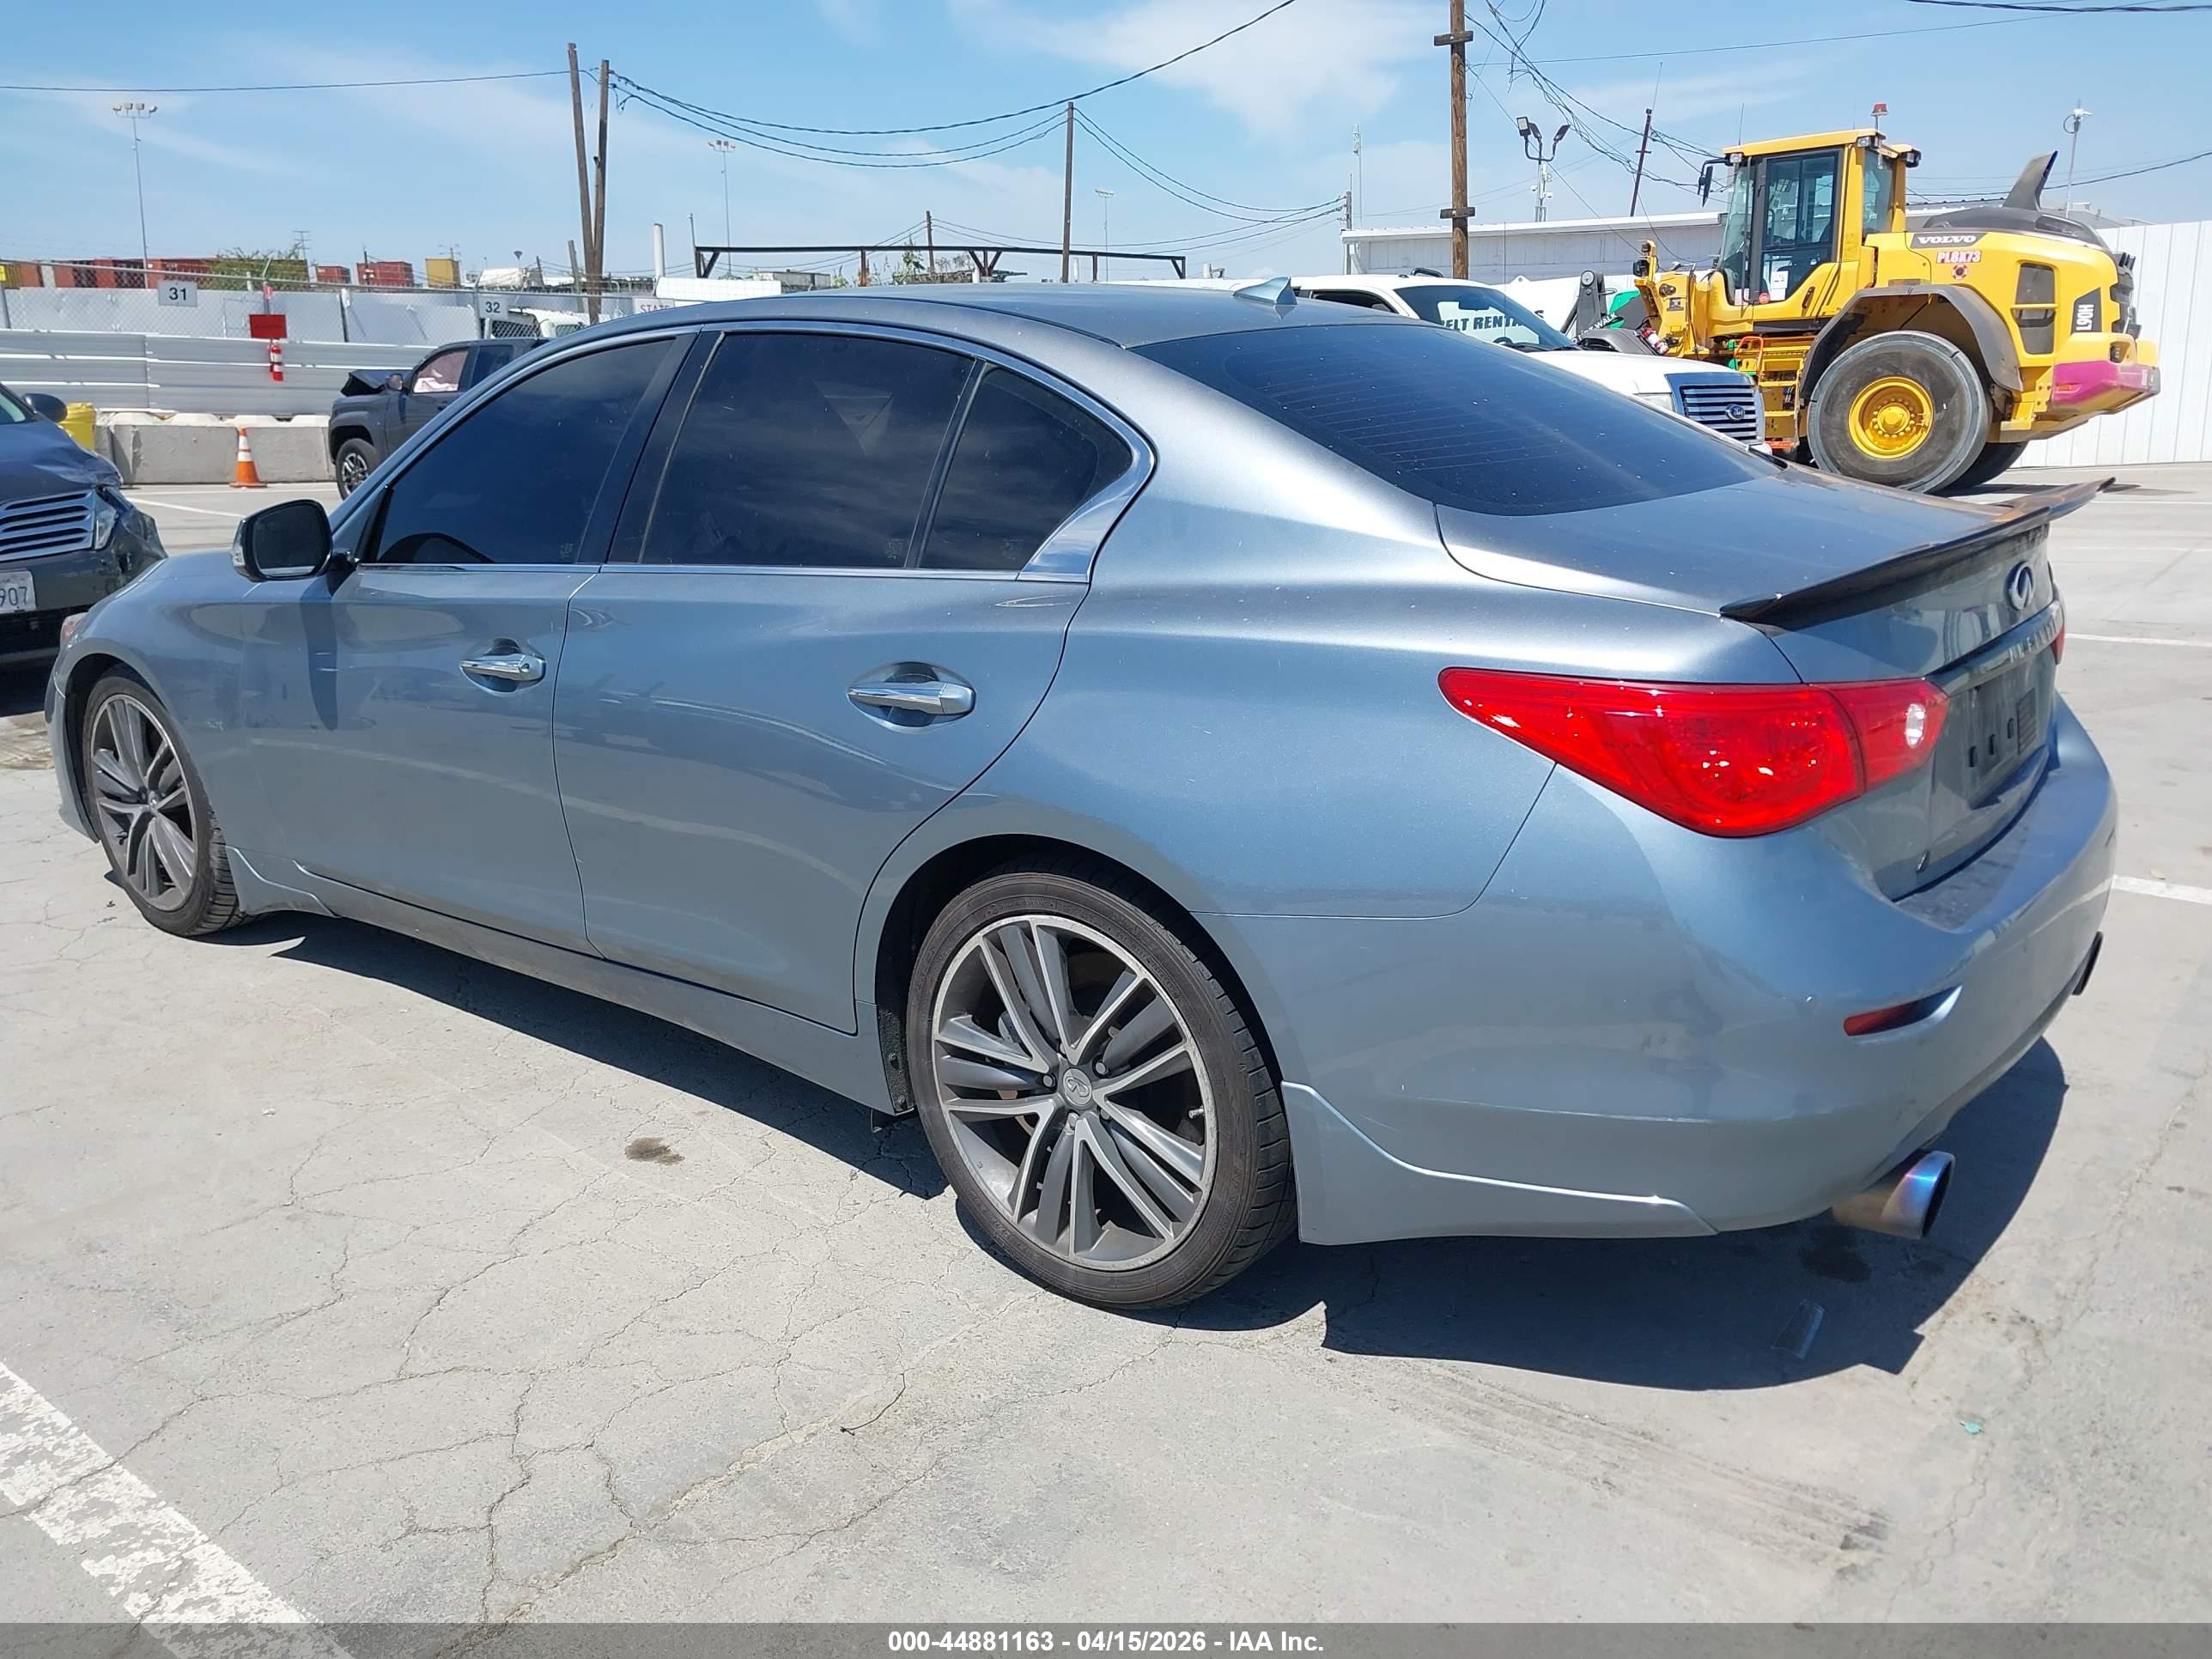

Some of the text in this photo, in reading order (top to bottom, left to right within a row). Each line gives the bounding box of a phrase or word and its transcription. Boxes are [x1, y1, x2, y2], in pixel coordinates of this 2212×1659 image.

[1917, 235, 1977, 244] VOLVO
[168, 287, 186, 301] 31
[485, 301, 501, 313] 32
[1595, 312, 1617, 328] WALK
[2075, 304, 2094, 331] L90H
